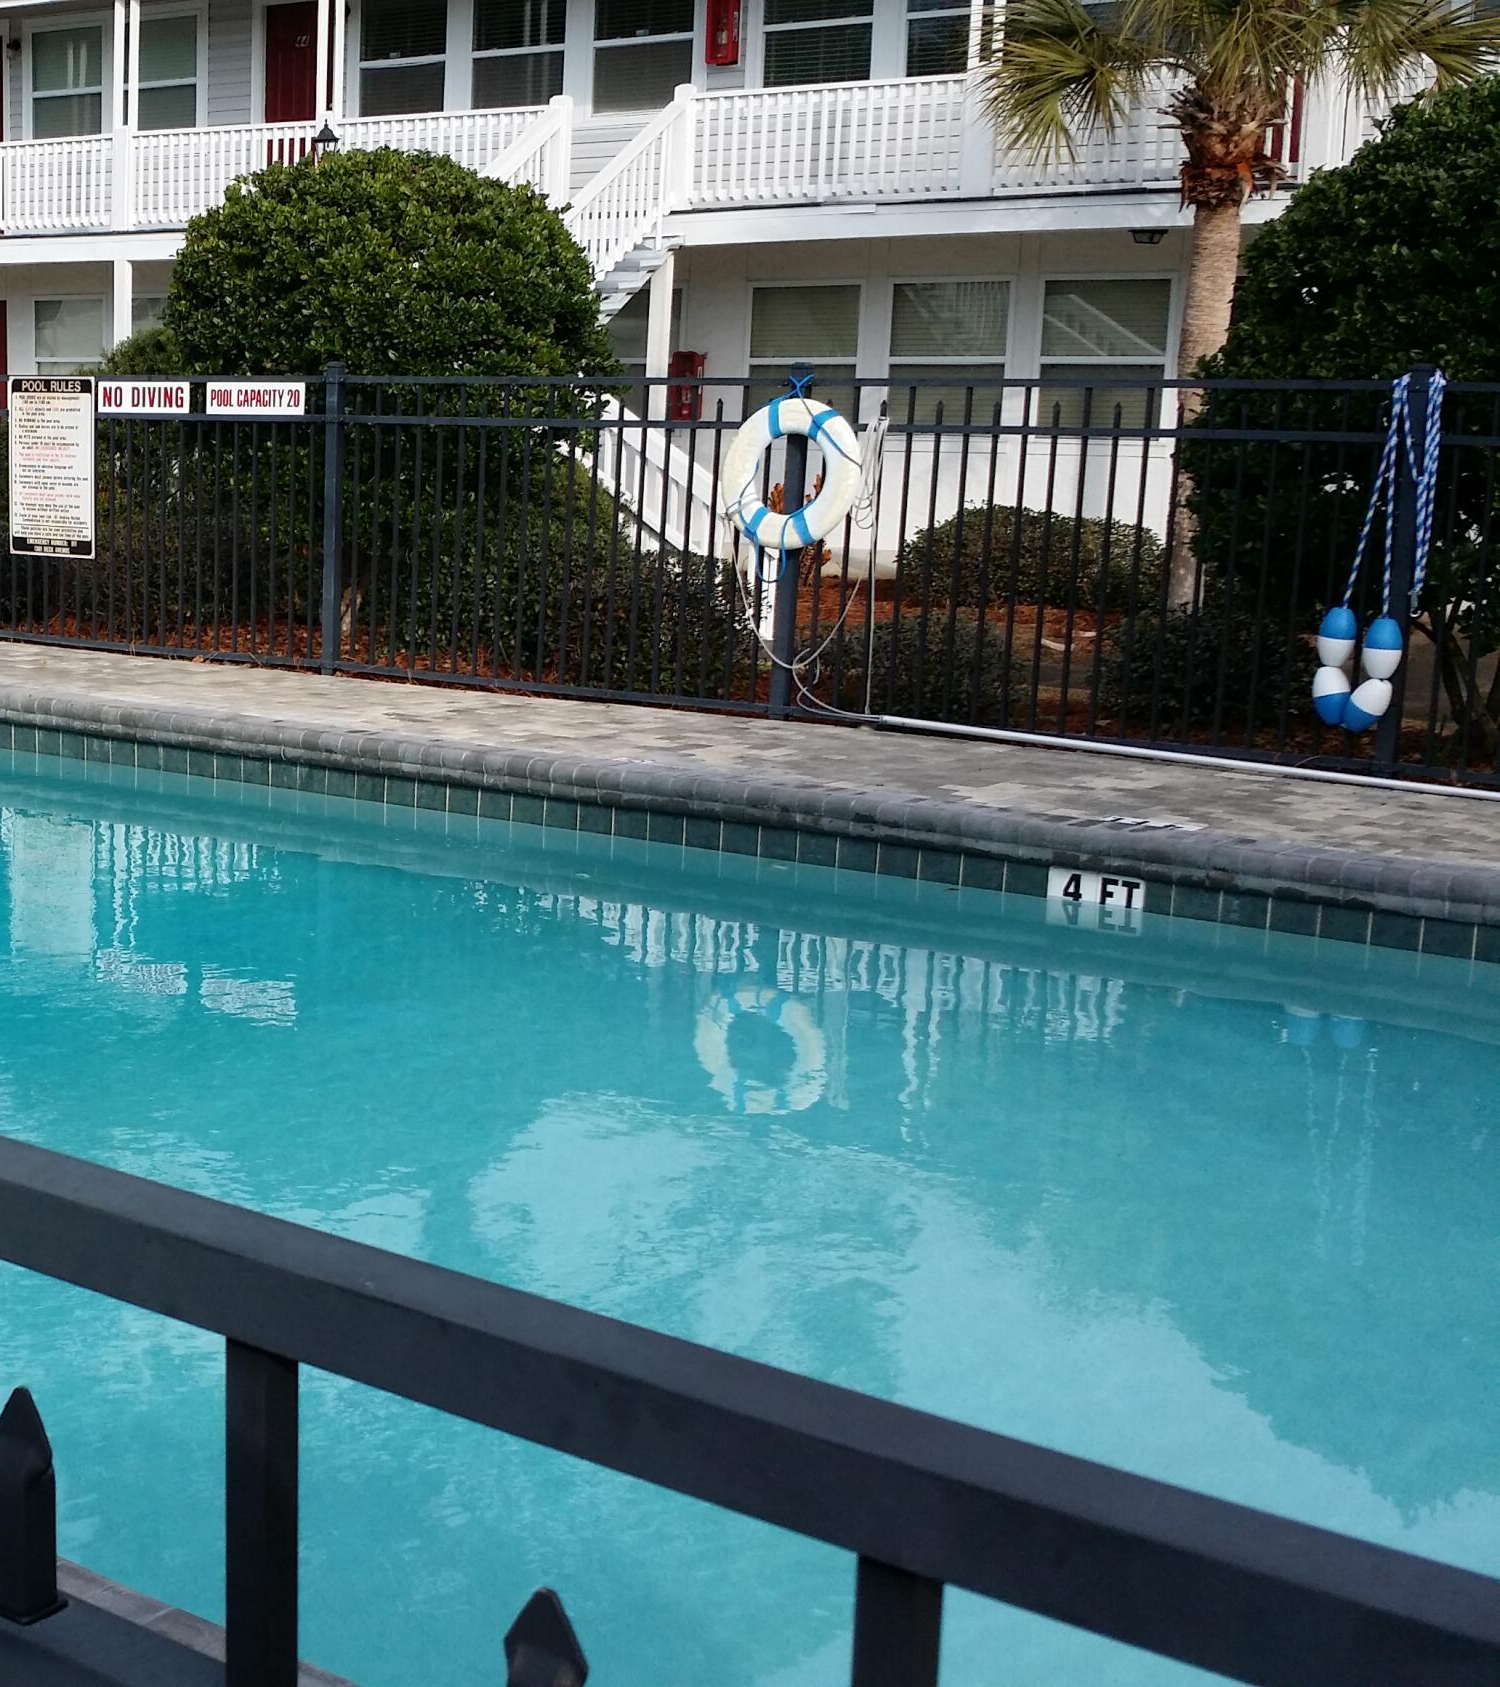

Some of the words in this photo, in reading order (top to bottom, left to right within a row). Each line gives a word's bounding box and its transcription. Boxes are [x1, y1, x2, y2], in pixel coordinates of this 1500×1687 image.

[21, 380, 48, 392] POOL
[50, 380, 82, 393] RULES
[102, 386, 123, 408] NO
[131, 386, 185, 408] DIVING
[210, 389, 234, 408] POOL
[236, 389, 285, 408] CAPACITY
[287, 389, 301, 408] 20
[1062, 873, 1083, 902] 4
[1099, 877, 1141, 909] FT
